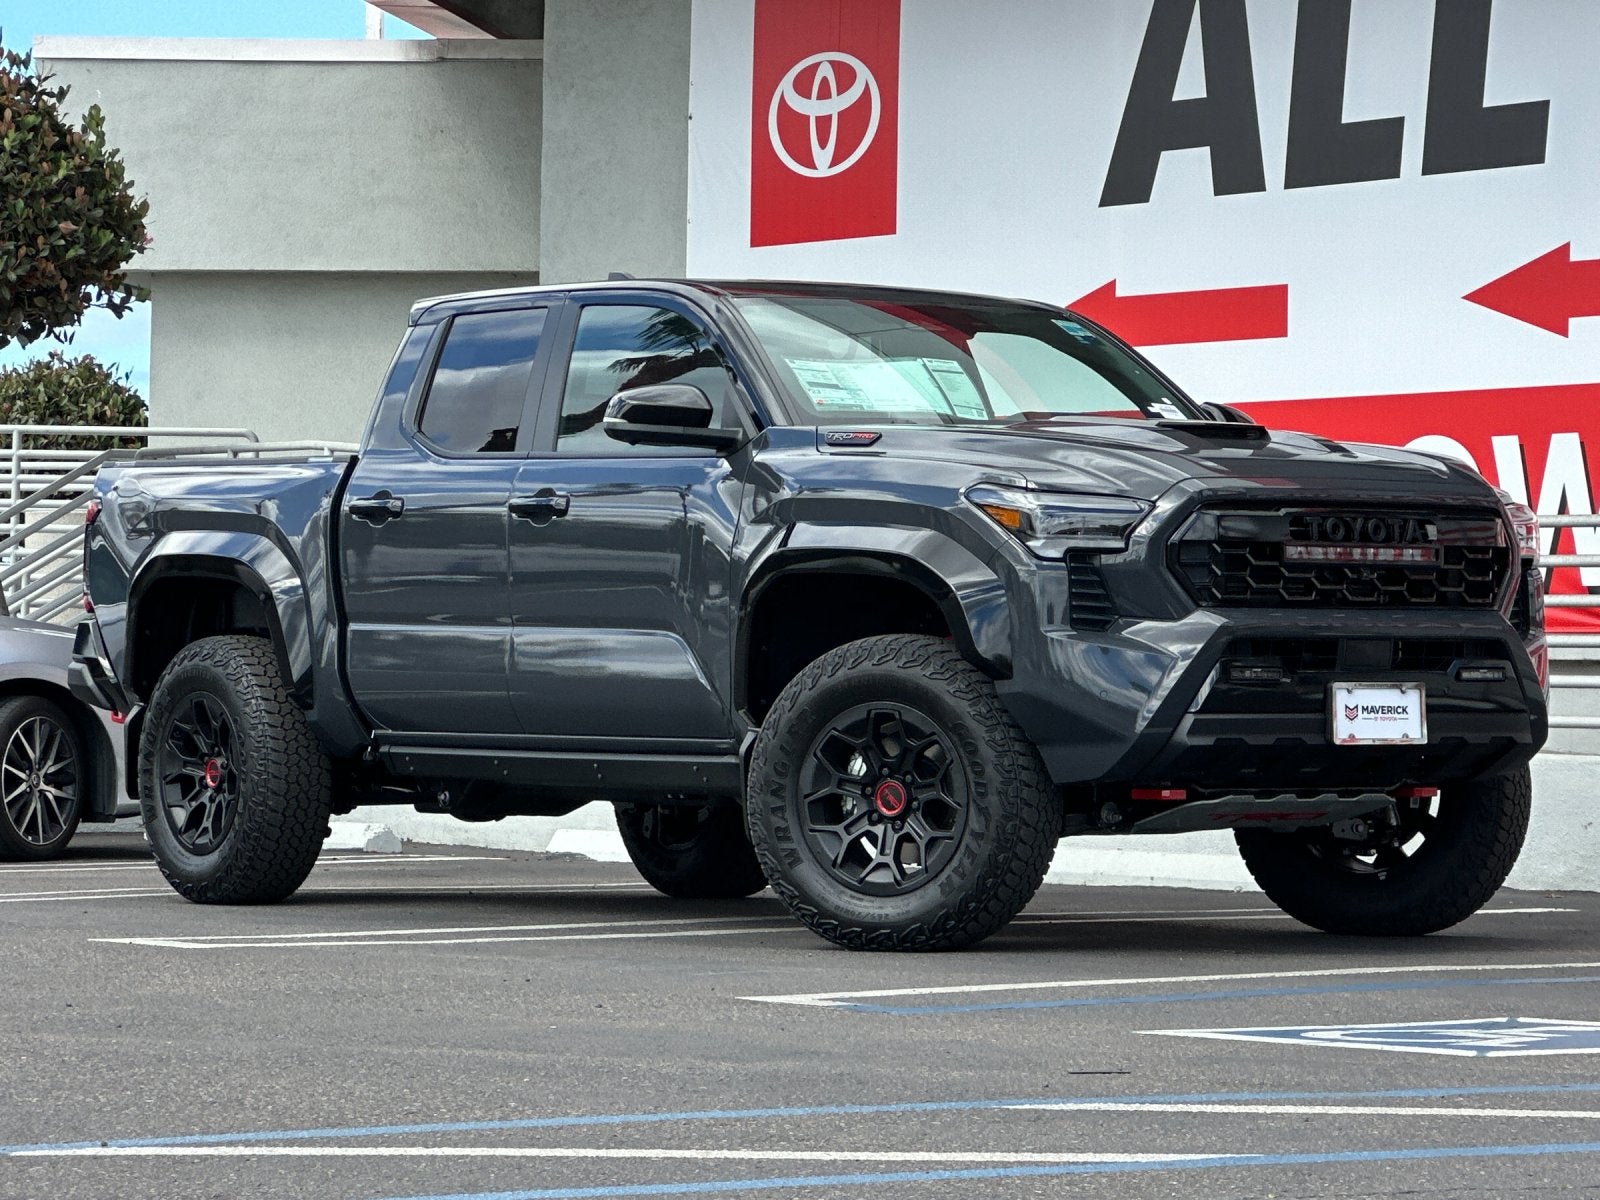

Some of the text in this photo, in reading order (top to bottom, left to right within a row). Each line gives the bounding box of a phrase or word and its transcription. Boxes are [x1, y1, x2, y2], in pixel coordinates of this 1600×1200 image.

[1099, 0, 1551, 208] ALL
[1304, 516, 1425, 543] TOYOTA
[1403, 433, 1600, 596] W
[1361, 705, 1409, 715] MAVERICK
[938, 721, 992, 899] GOODYEAR
